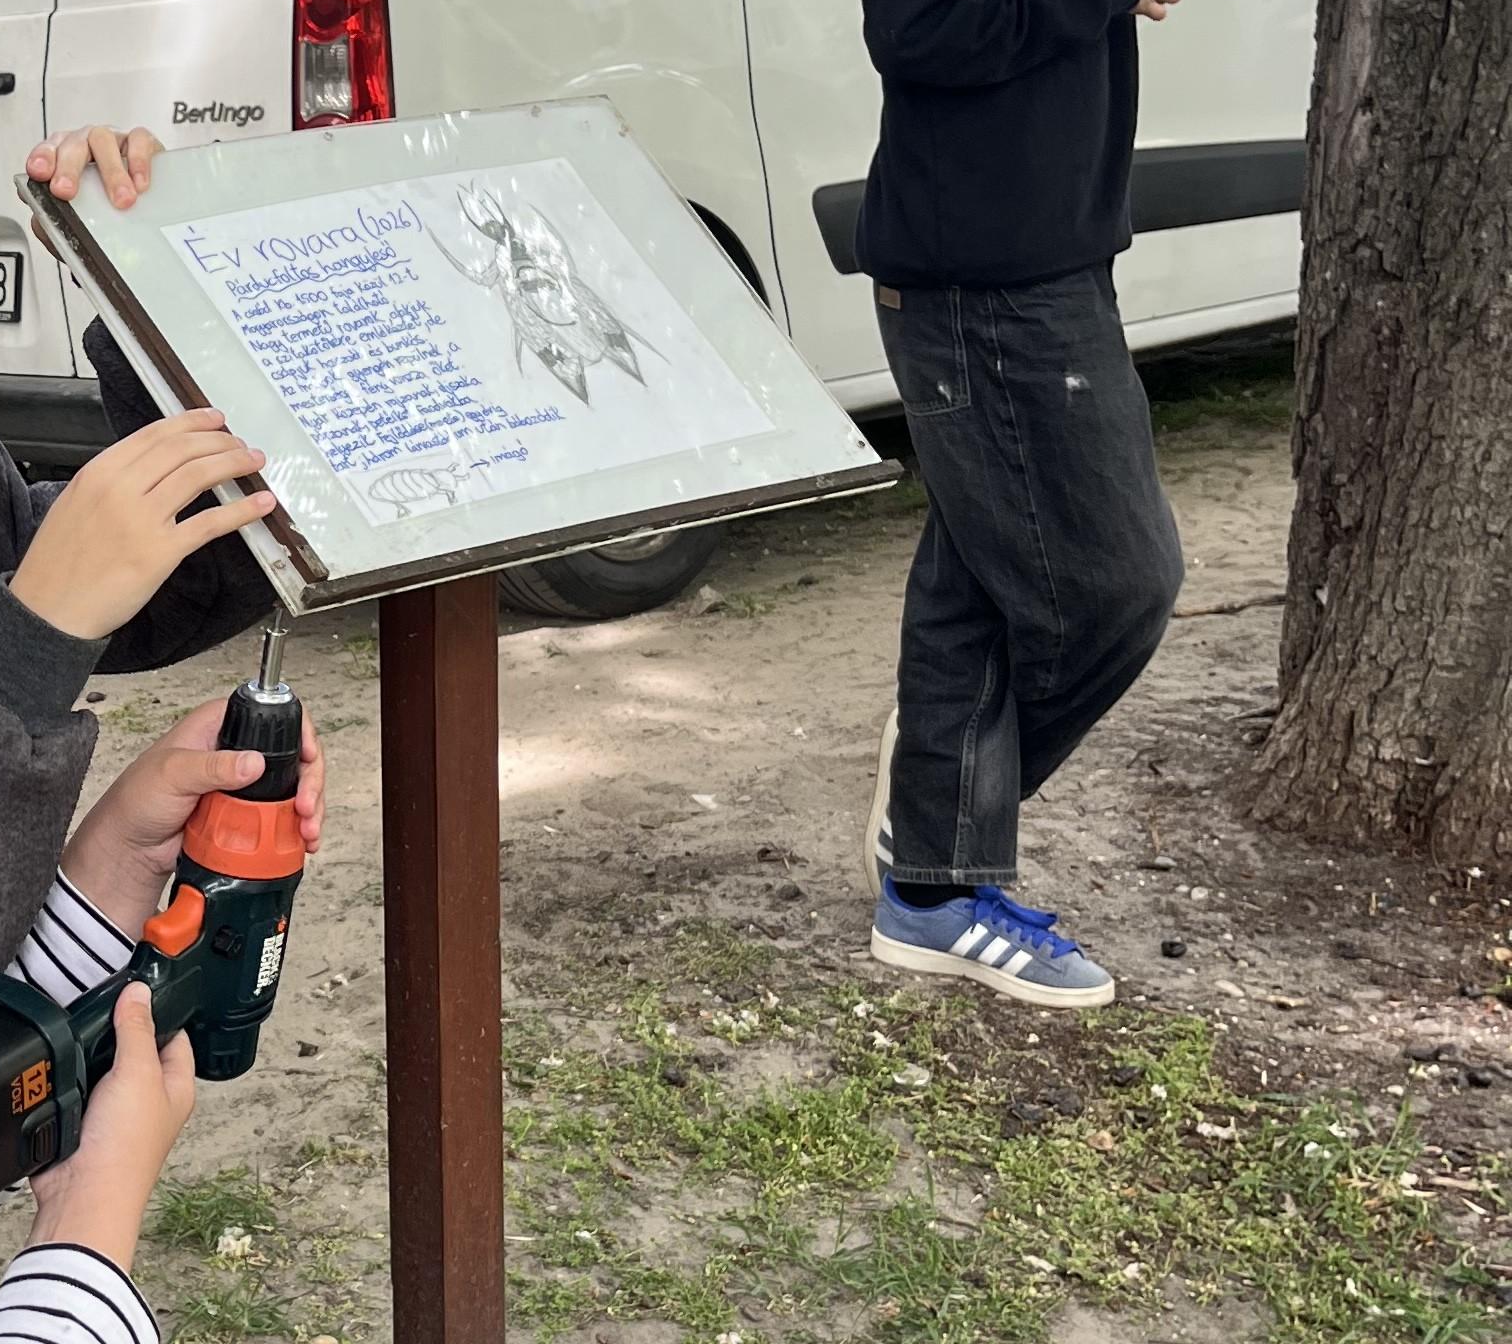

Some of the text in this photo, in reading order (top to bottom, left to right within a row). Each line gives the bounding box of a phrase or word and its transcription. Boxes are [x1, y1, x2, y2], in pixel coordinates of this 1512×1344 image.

[172, 100, 265, 126] Berlingo
[184, 199, 423, 273] Év rovara (2026)
[11, 1075, 23, 1115] VOLT
[29, 1069, 43, 1101] 12
